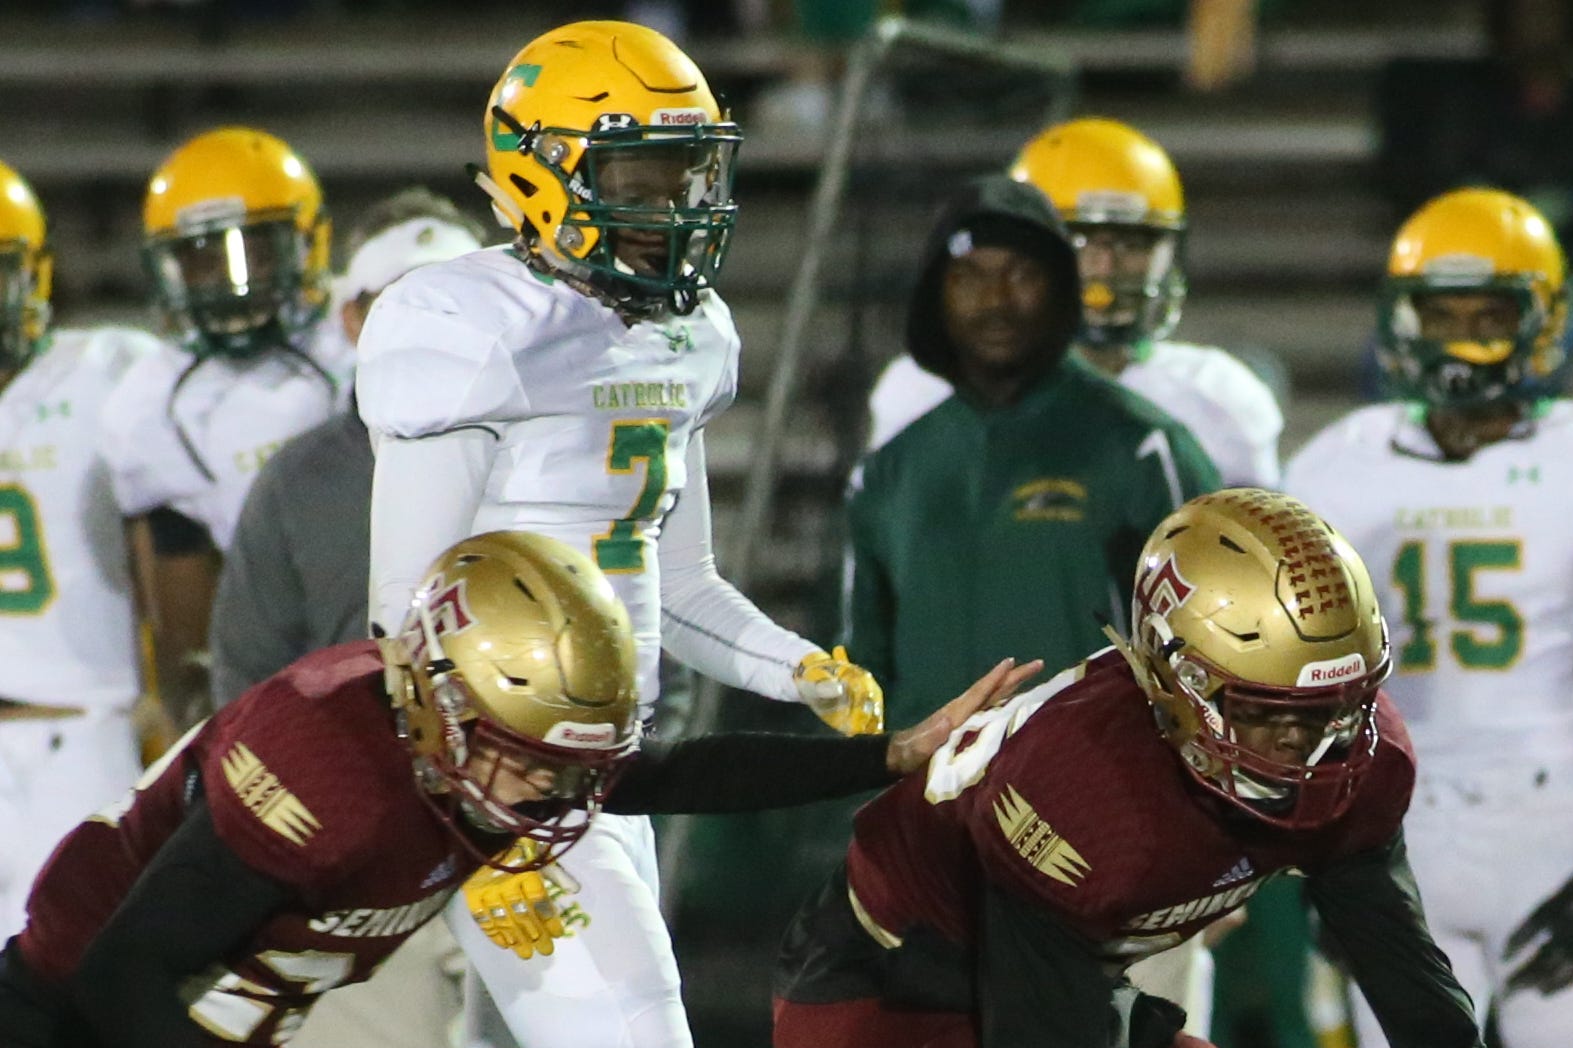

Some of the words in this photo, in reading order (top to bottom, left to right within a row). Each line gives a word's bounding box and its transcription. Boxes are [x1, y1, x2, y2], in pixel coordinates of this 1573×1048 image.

[592, 383, 688, 411] CATHOLIC
[592, 418, 672, 575] 7
[1392, 539, 1525, 671] 15
[1311, 661, 1361, 681] Riddell
